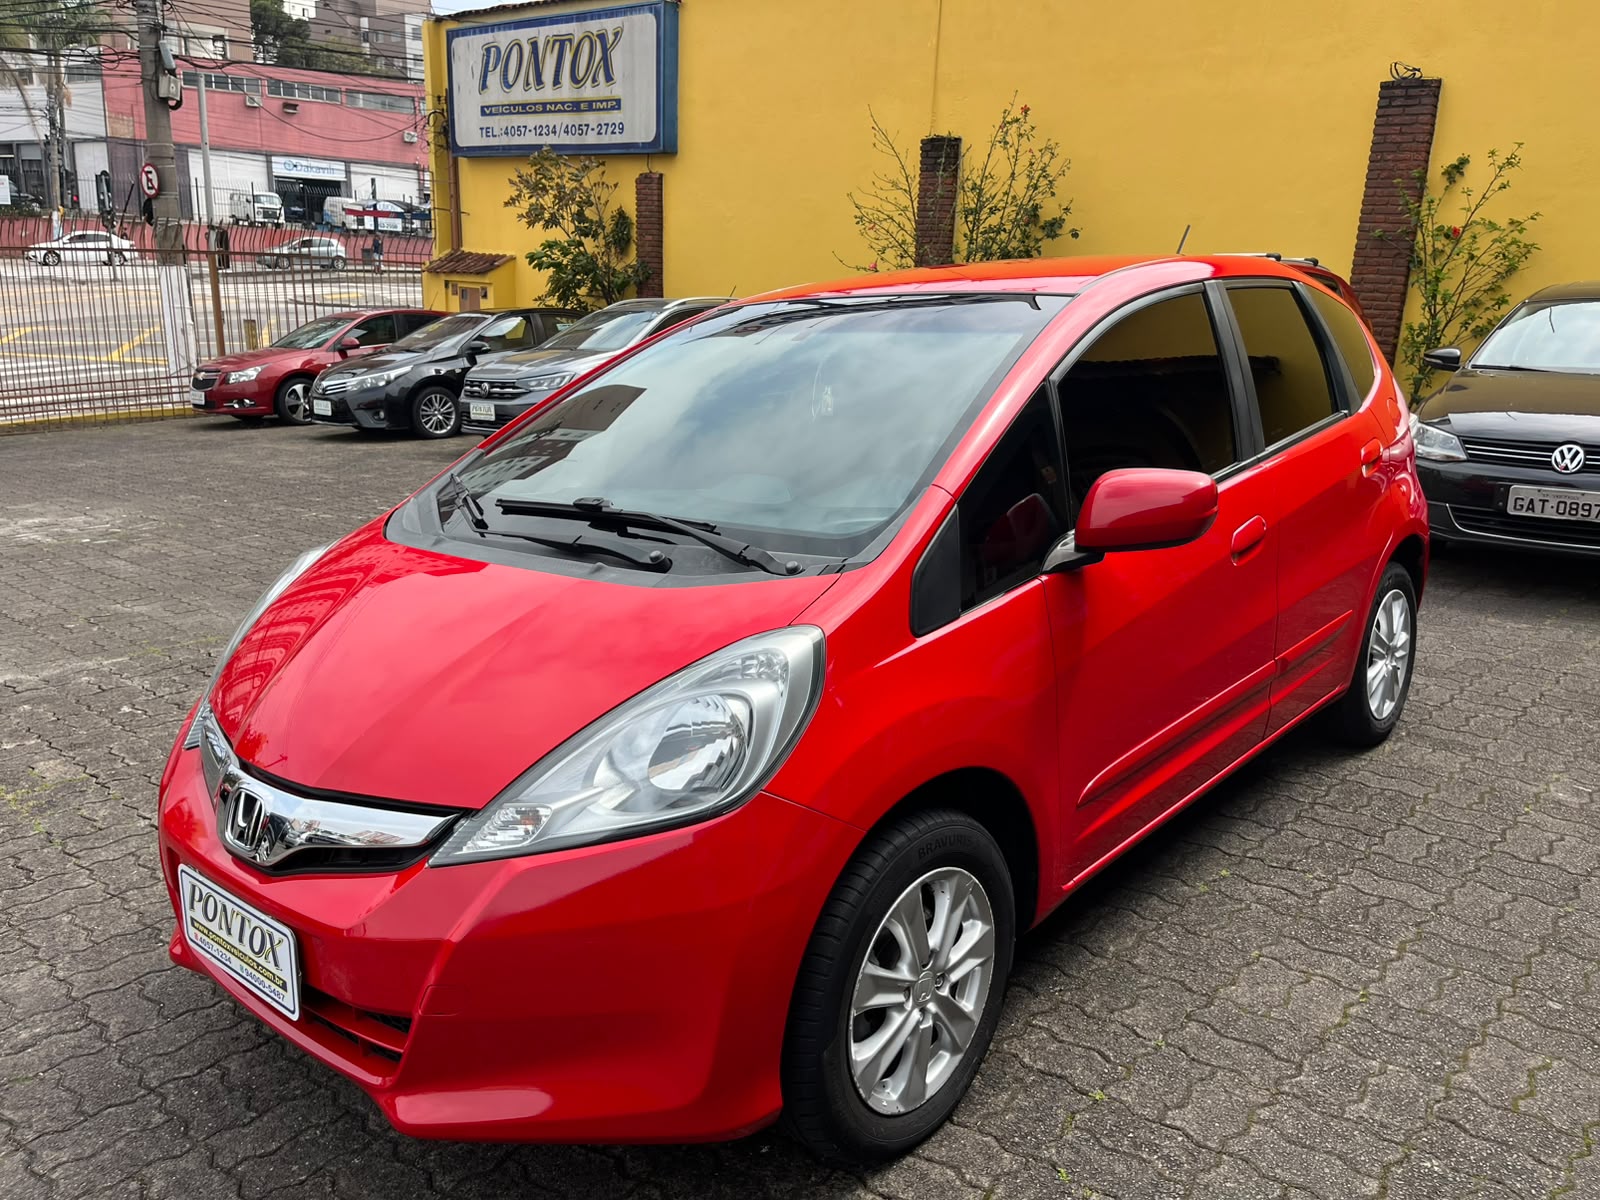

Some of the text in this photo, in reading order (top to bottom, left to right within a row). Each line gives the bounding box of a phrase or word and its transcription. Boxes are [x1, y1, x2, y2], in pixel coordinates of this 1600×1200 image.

[479, 26, 624, 95] PONTOX
[546, 102, 577, 112] NAC.
[580, 102, 589, 110] E
[592, 100, 619, 109] IMP.
[188, 881, 284, 972] PONTOX
[193, 921, 284, 987] www.pontoxveiculos.com.br
[199, 937, 232, 965] 4057-1234
